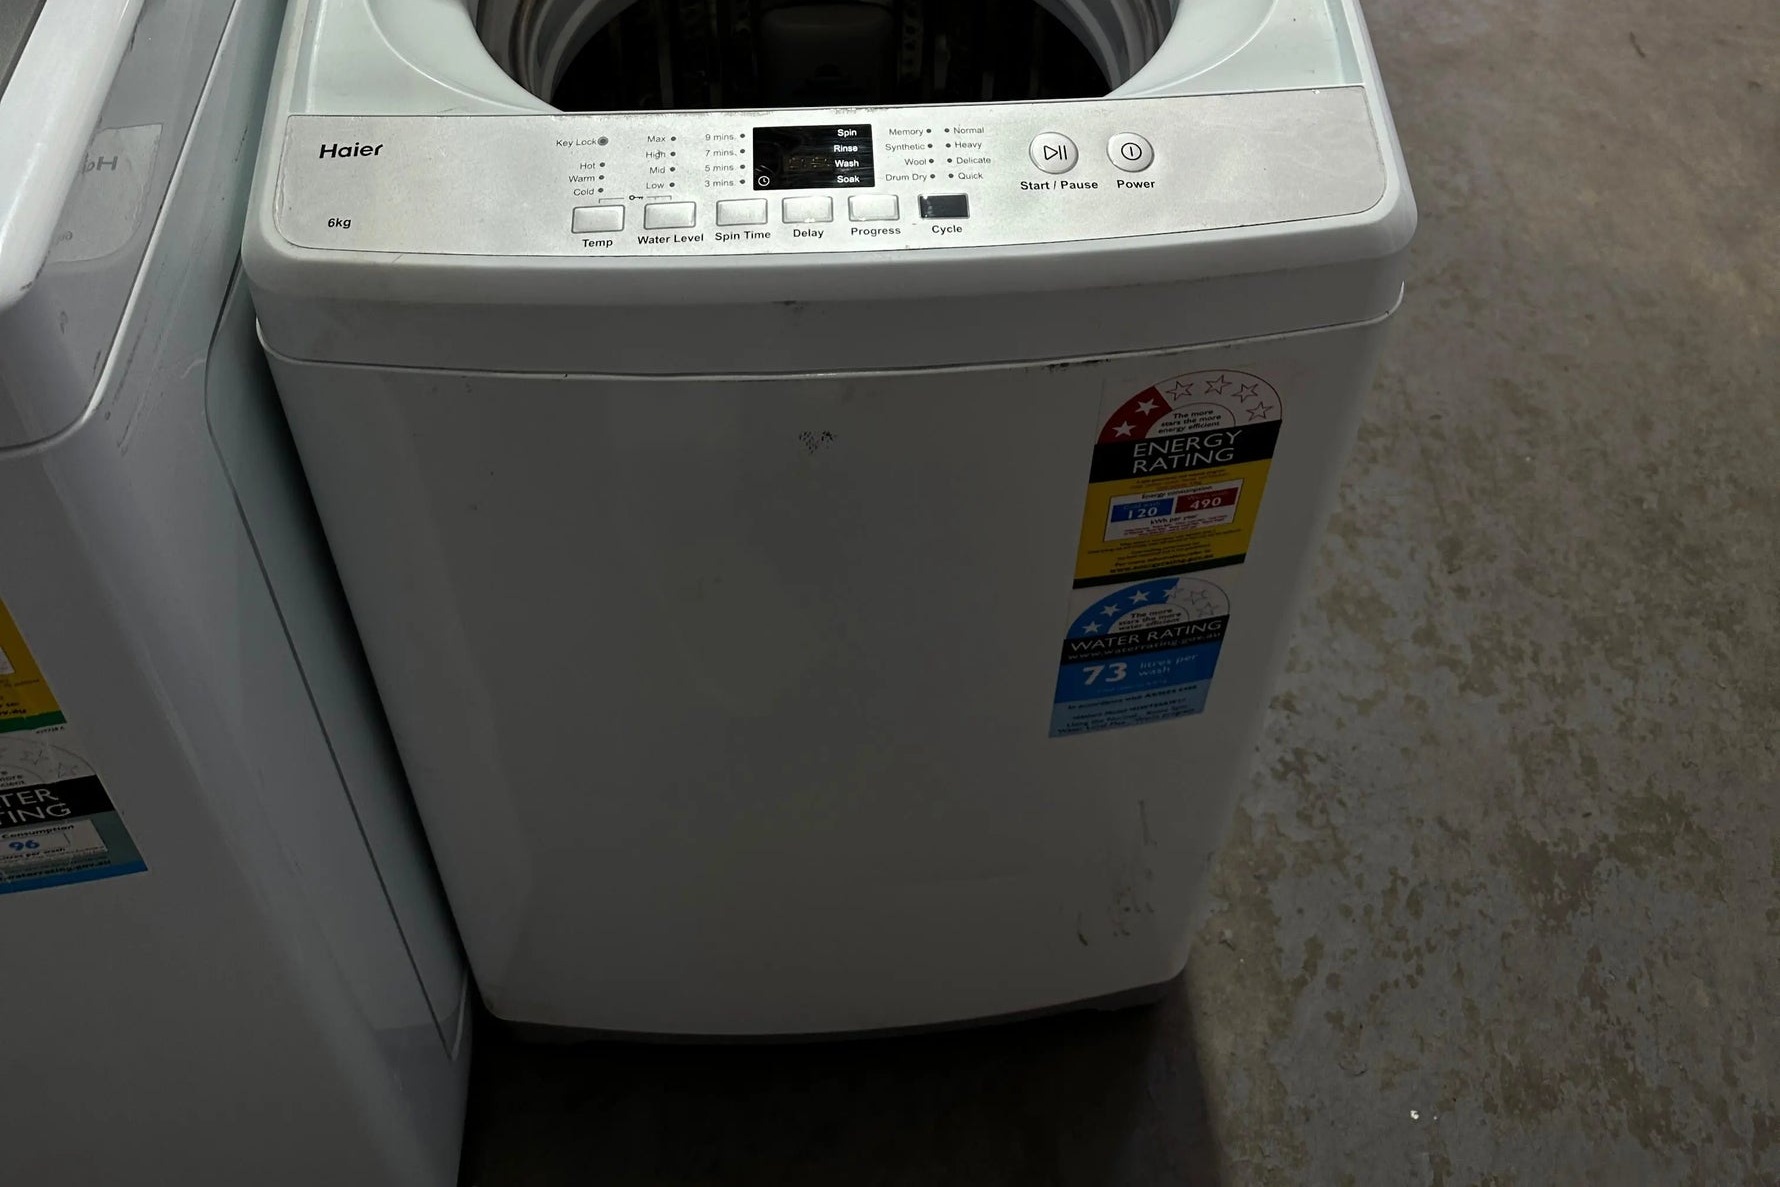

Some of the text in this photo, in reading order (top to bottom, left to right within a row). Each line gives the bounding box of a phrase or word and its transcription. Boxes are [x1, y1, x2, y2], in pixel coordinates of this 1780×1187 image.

[837, 128, 857, 139] Spin
[888, 127, 924, 137] Memory
[953, 126, 985, 135] Normal
[556, 137, 597, 148] Key Lock
[647, 135, 666, 143] Max
[705, 133, 711, 142] 9
[318, 141, 384, 159] Haier
[833, 143, 859, 153] Rinse
[884, 142, 926, 152] Synthetic
[954, 140, 983, 151] Heavy
[645, 150, 666, 160] High
[705, 149, 711, 158] 7
[579, 162, 596, 170] Hot
[834, 158, 860, 168] Wash
[904, 157, 927, 166] Wool
[956, 156, 992, 165] Delicate
[649, 166, 666, 175] Mid
[704, 164, 711, 173] 5
[568, 174, 596, 183] Warm
[836, 174, 861, 184] Soak
[885, 172, 928, 184] Drum Dry
[957, 171, 984, 181] Quick
[646, 181, 665, 190] Low
[704, 179, 711, 188] 3
[1020, 180, 1050, 191] Start
[1060, 180, 1099, 190] Pause
[1116, 179, 1156, 189] Power
[573, 188, 595, 197] Cold
[327, 217, 352, 230] 6kg
[792, 227, 825, 240] Delay
[850, 225, 902, 238] Progress
[931, 224, 963, 235] Cycle
[637, 233, 705, 245] Water Level
[714, 230, 771, 243] Spin Time
[582, 237, 613, 250] Temp
[1190, 409, 1214, 417] more
[1199, 414, 1222, 422] more
[1158, 421, 1220, 434] energy efficient
[1133, 429, 1243, 458] ENERGY
[1132, 447, 1235, 474] RATING
[1141, 491, 1166, 501] Energy
[1167, 485, 1213, 497] consumption
[1190, 496, 1222, 510] 490
[1127, 506, 1158, 519] 120
[1158, 612, 1182, 620] more
[1070, 620, 1223, 652] WATER RATING
[1082, 661, 1128, 686] 73
[1138, 666, 1171, 678] wash
[0, 788, 59, 808] TER
[1, 824, 75, 839] Consumption
[8, 839, 40, 851] 96
